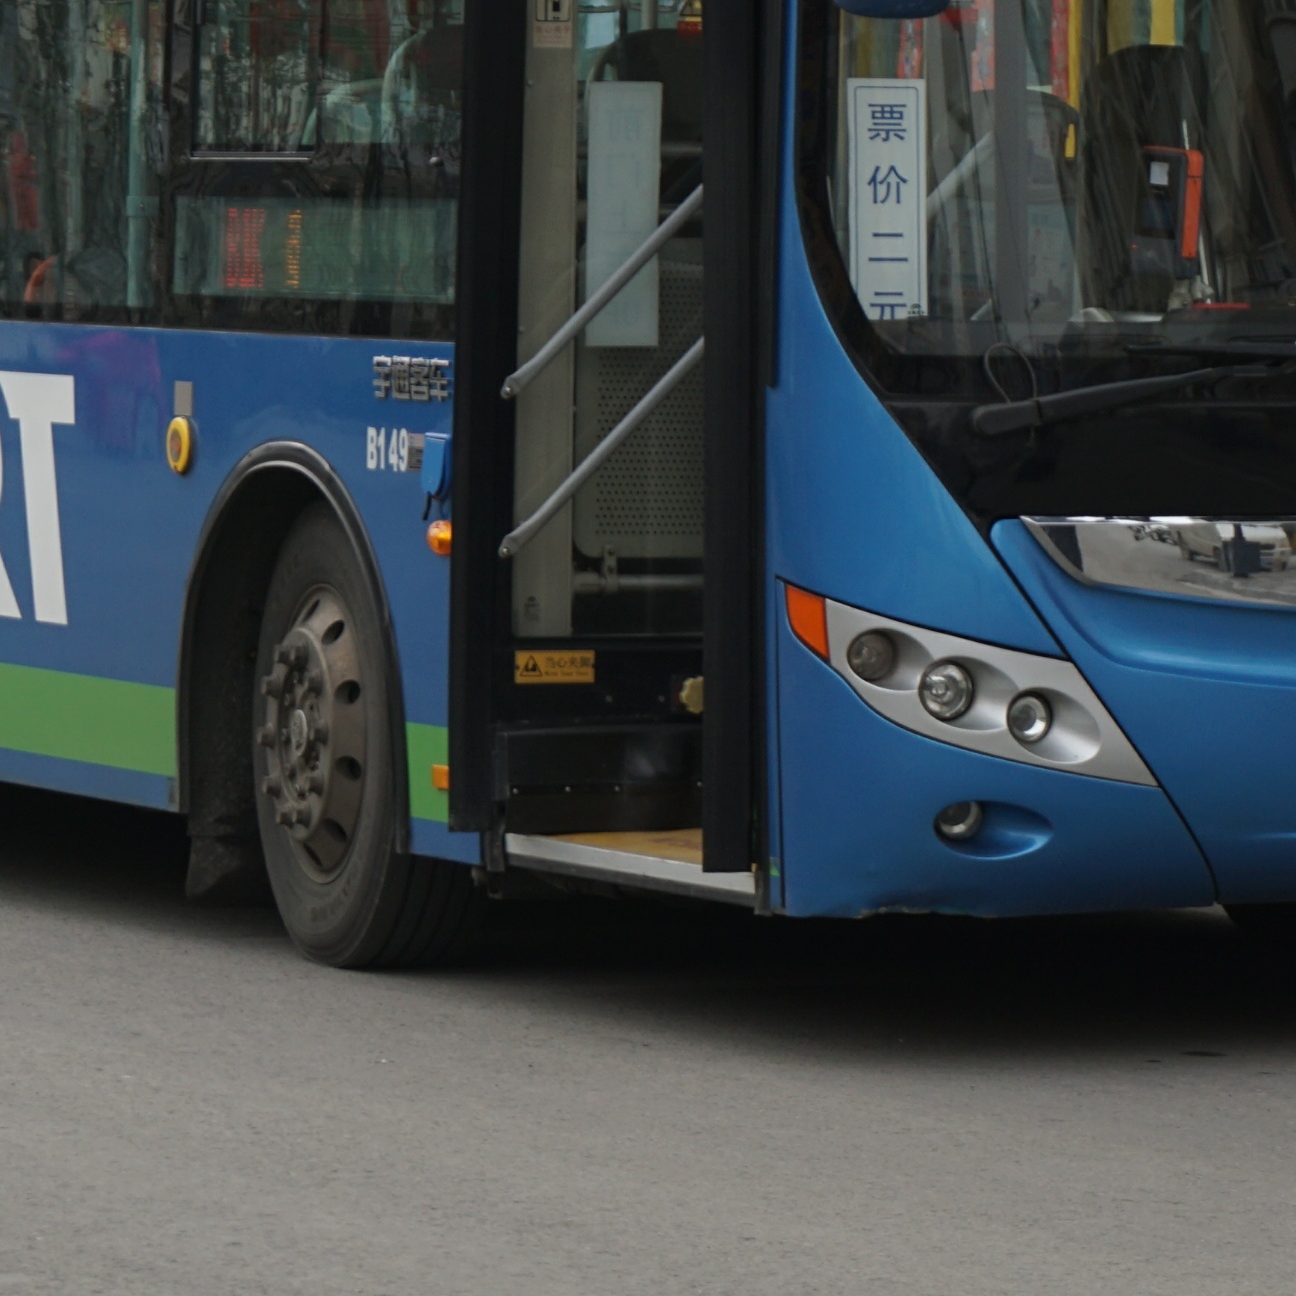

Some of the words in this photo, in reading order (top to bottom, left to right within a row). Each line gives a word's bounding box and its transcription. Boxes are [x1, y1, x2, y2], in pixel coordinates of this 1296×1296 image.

[867, 103, 910, 321] 票价二元
[372, 355, 449, 402] 宇通客车
